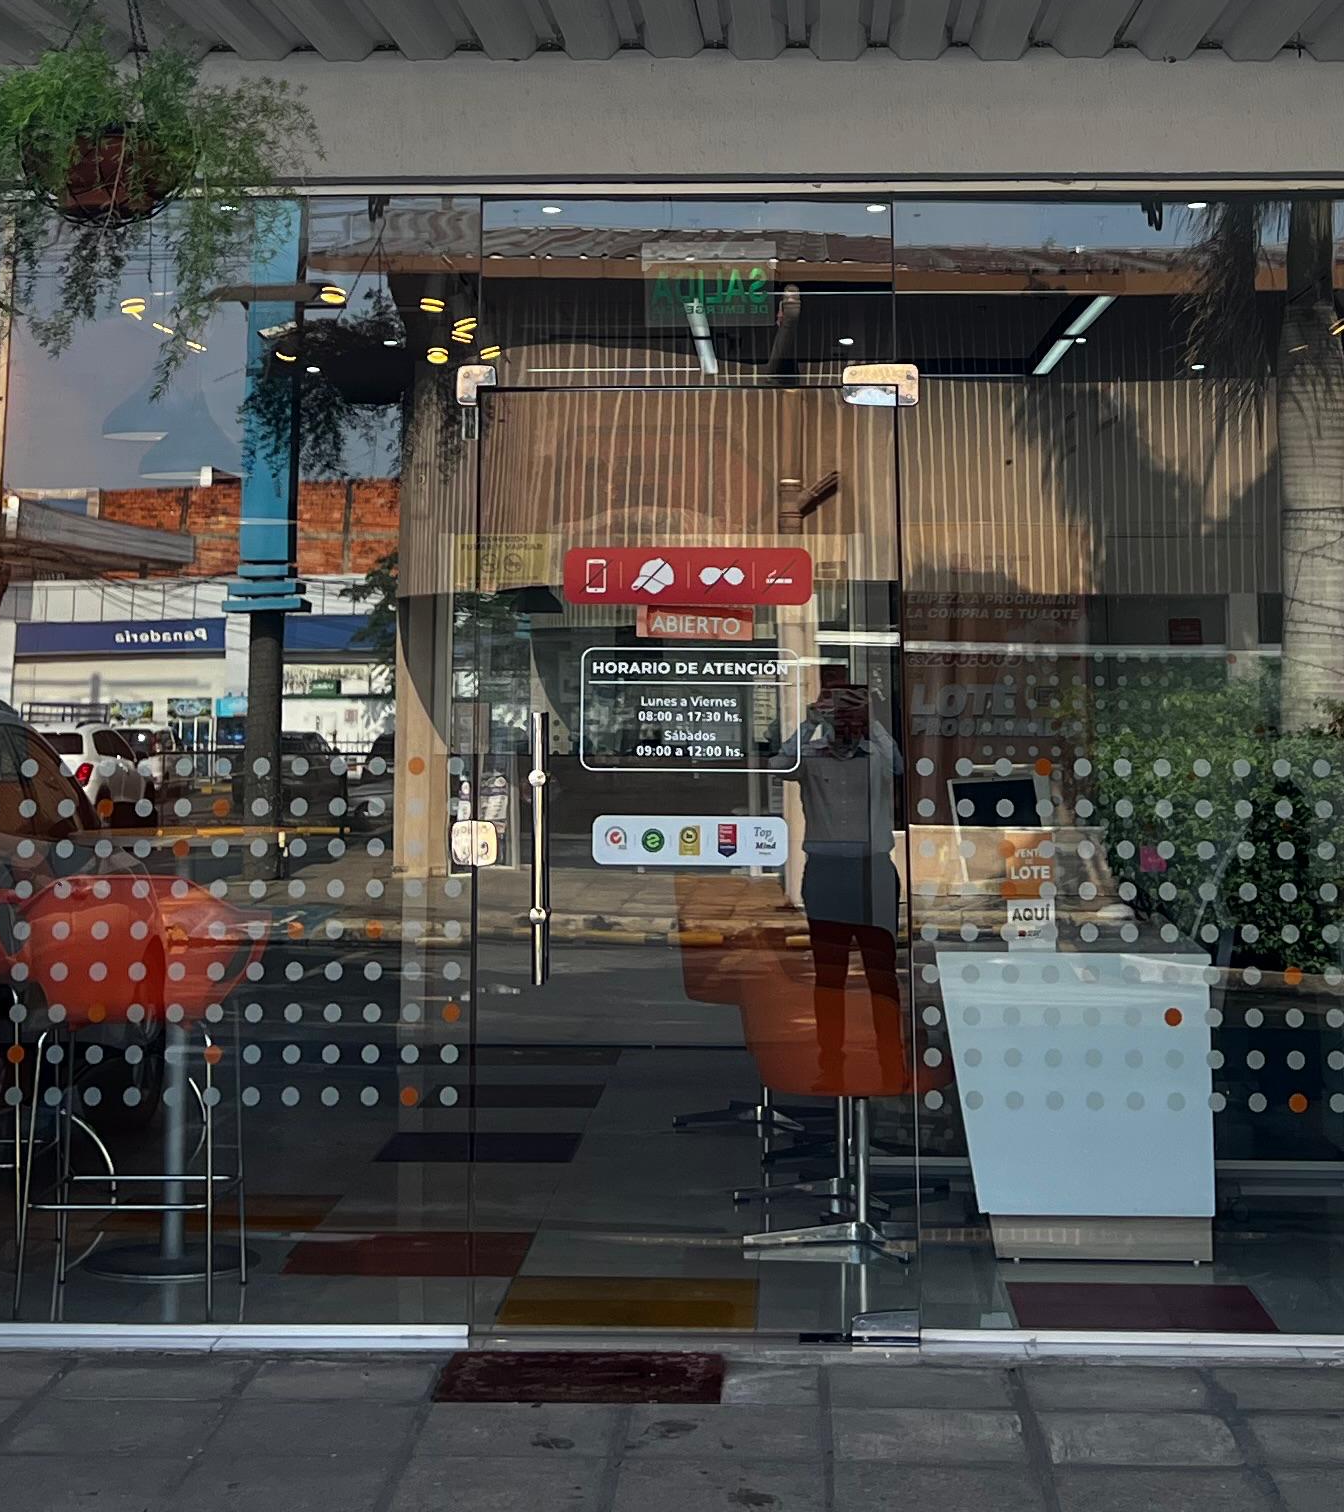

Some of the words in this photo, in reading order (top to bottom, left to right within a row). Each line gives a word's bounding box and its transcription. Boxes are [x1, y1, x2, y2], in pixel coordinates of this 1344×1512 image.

[984, 594, 1077, 606] PROGRAMAR
[928, 608, 989, 620] COMPRA
[993, 608, 1013, 620] DE
[1018, 608, 1038, 620] TU
[1039, 608, 1081, 621] LOTE
[651, 614, 741, 636] ABIERTO
[592, 661, 671, 675] HORARIO
[675, 662, 698, 675] DE
[702, 659, 789, 676] ATENCIÓN
[640, 696, 677, 707] Lunes
[680, 698, 687, 707] a
[690, 695, 737, 708] Viernes
[911, 683, 1018, 717] LOTE
[638, 711, 672, 722] 08:00
[676, 713, 683, 722] a
[687, 711, 721, 722] 17:30
[724, 711, 743, 723] hs.
[664, 729, 716, 741] Sábados
[636, 745, 672, 757] 09:00
[675, 747, 683, 757] a
[687, 745, 722, 757] 12:00
[725, 745, 744, 758] hs.
[753, 826, 772, 838] Top
[755, 841, 776, 850] Mind
[1010, 865, 1051, 880] LOTE
[1012, 903, 1051, 921] AQUÍ
